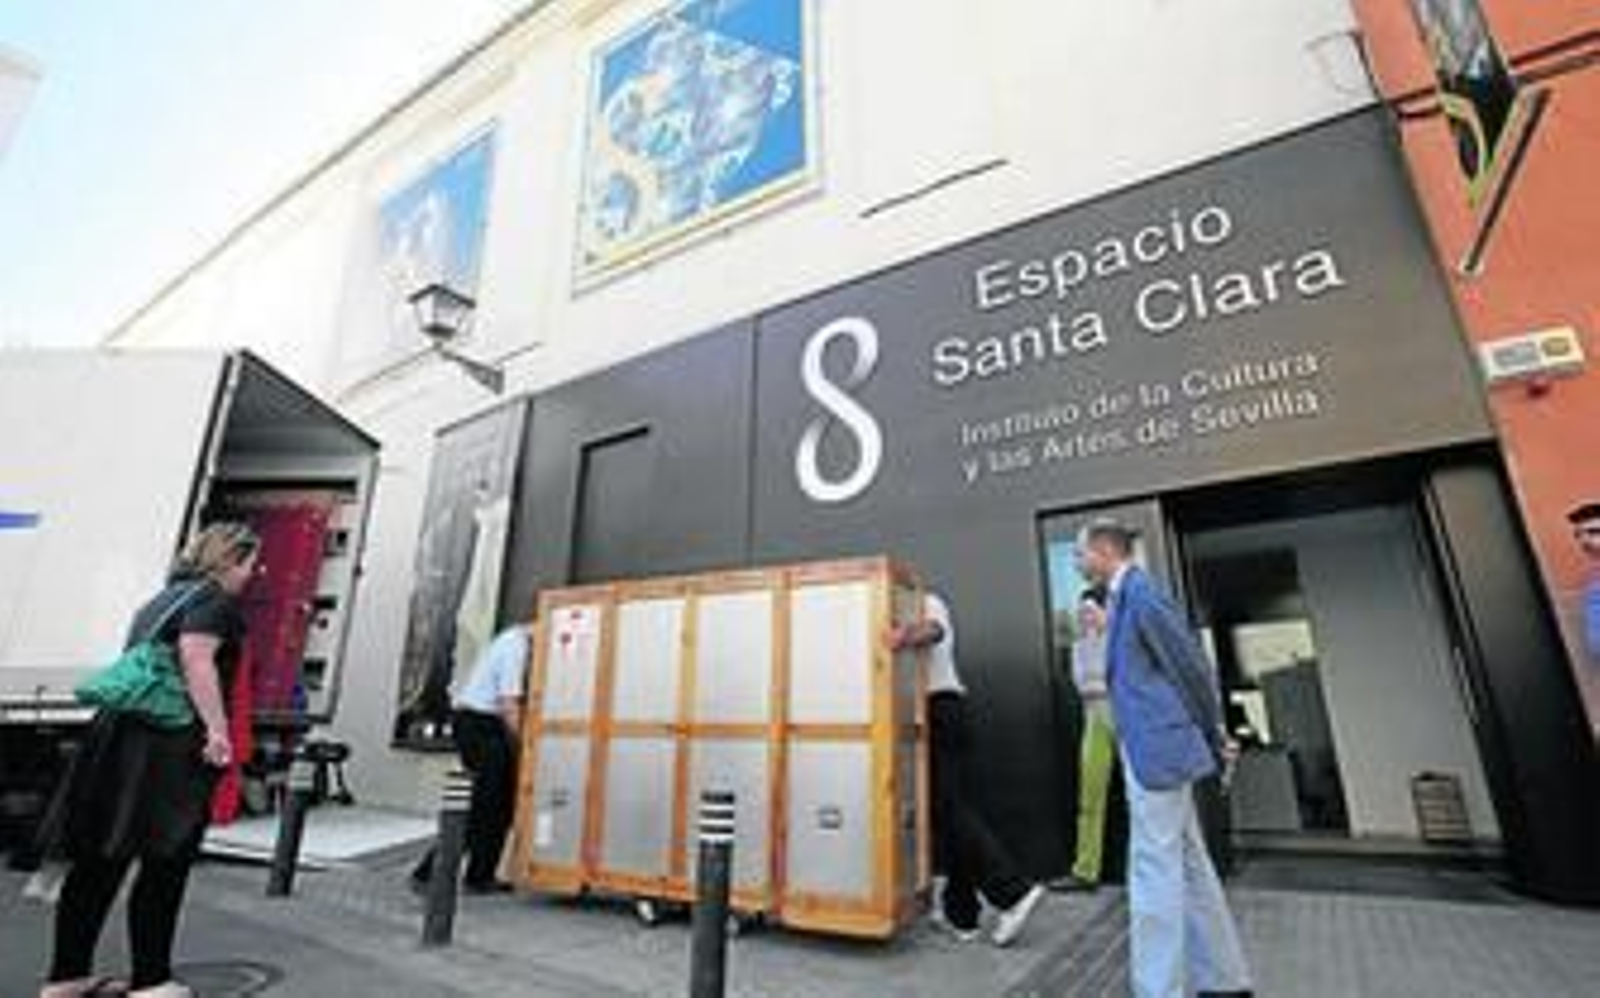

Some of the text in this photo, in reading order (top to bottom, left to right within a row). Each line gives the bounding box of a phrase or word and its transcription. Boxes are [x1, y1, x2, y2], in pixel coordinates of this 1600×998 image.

[975, 205, 1232, 310] Espacio
[933, 247, 1345, 386] Santa Clara
[1181, 354, 1318, 397] Cultura
[1191, 389, 1318, 435] Sevilla
